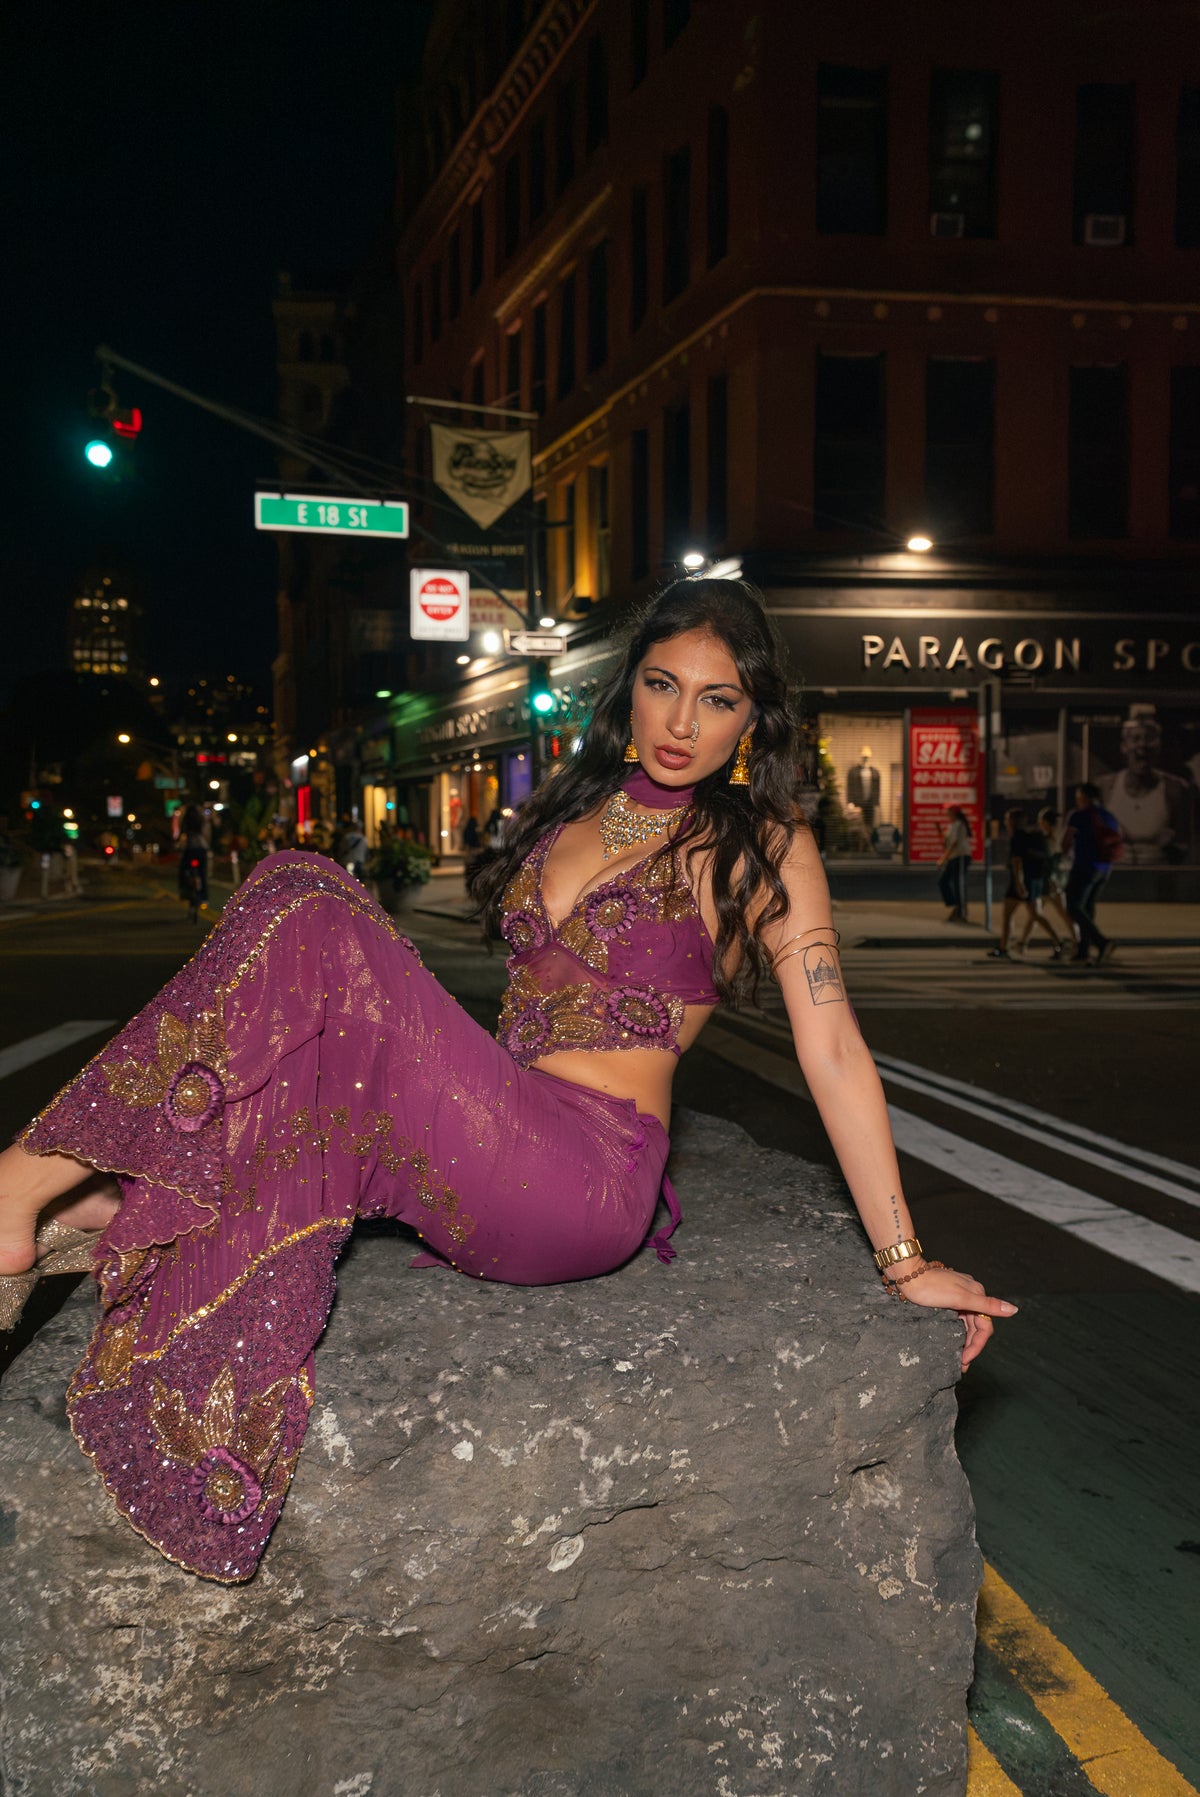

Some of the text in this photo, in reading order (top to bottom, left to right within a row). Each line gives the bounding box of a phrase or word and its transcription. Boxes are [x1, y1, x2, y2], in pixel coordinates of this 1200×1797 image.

[297, 503, 368, 528] E 18 St
[439, 584, 454, 593] NOT
[426, 606, 453, 615] ENTER
[862, 635, 1081, 671] PARAGON
[918, 741, 973, 764] SALE
